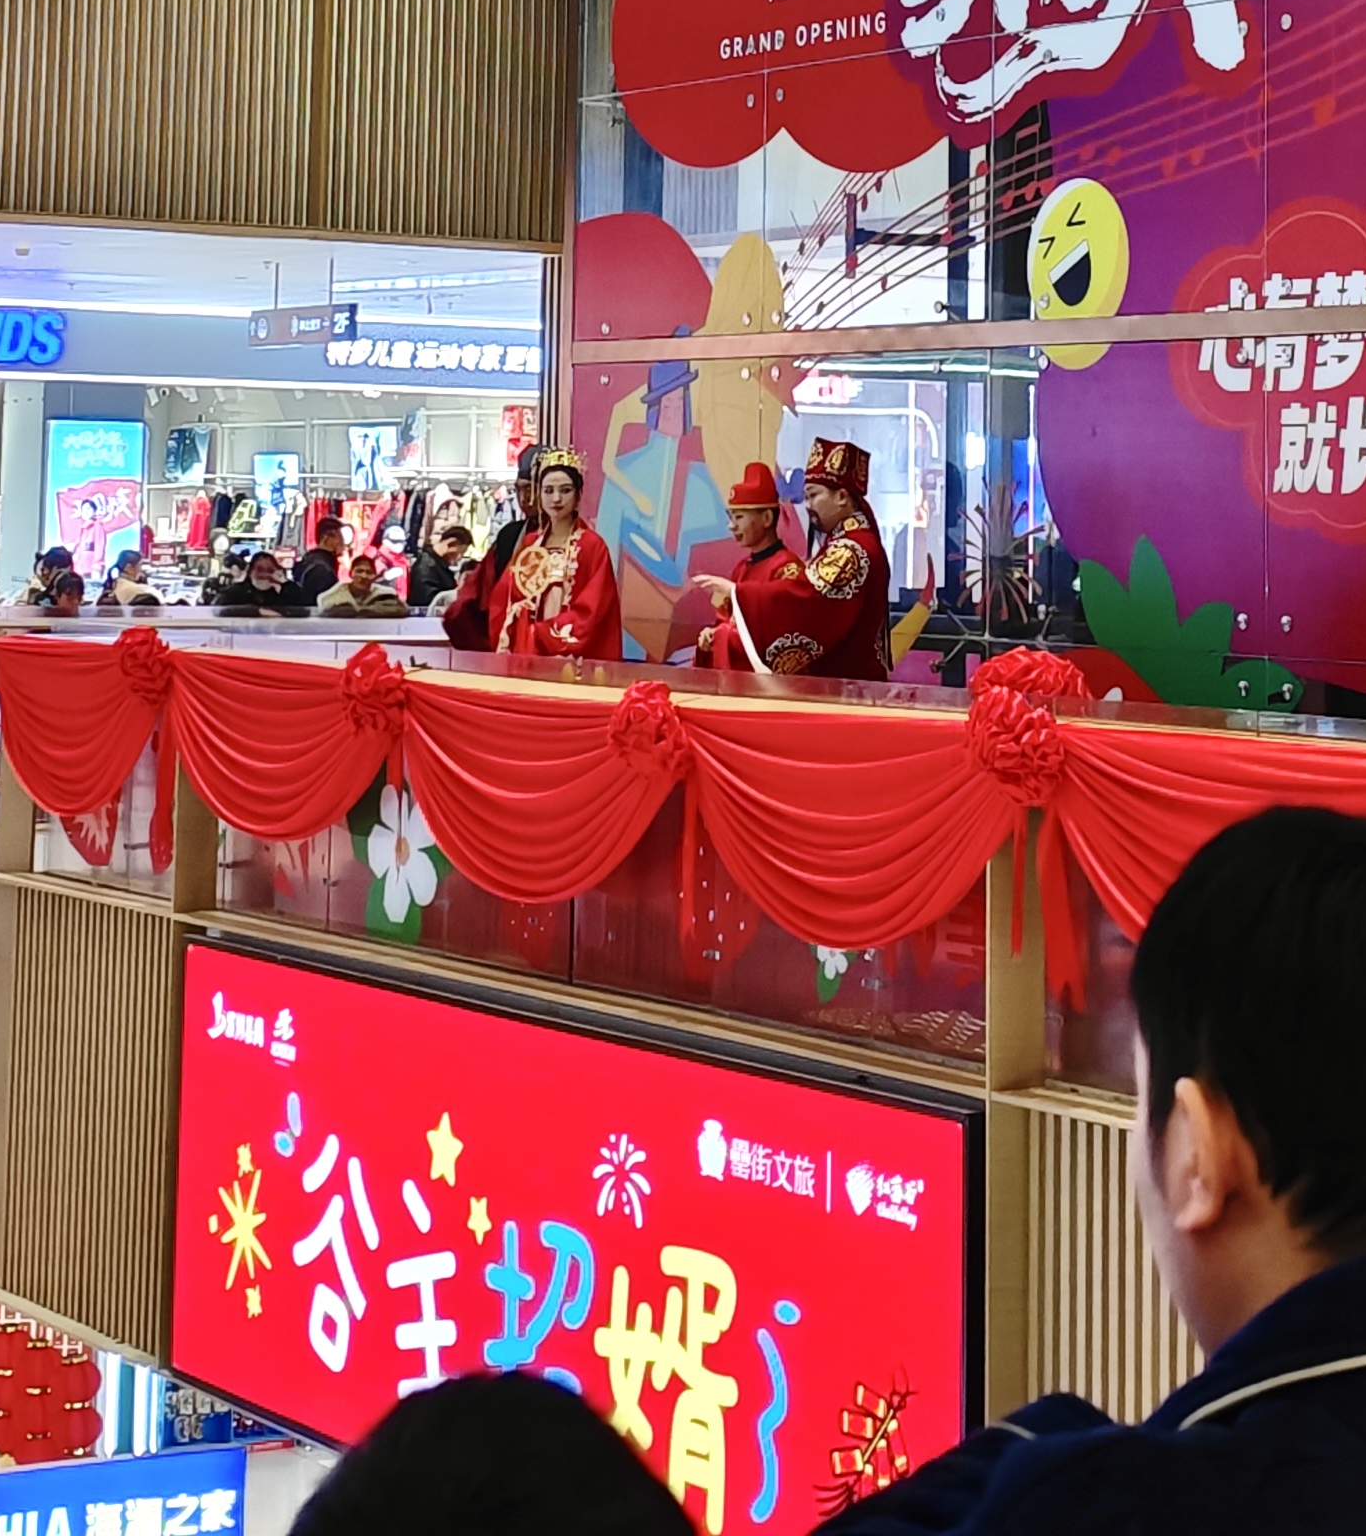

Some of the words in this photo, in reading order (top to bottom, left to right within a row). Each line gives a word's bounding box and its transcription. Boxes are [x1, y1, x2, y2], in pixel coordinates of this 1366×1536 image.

[719, 29, 786, 61] GRAND
[794, 12, 888, 52] OPENING
[332, 311, 351, 335] 2F
